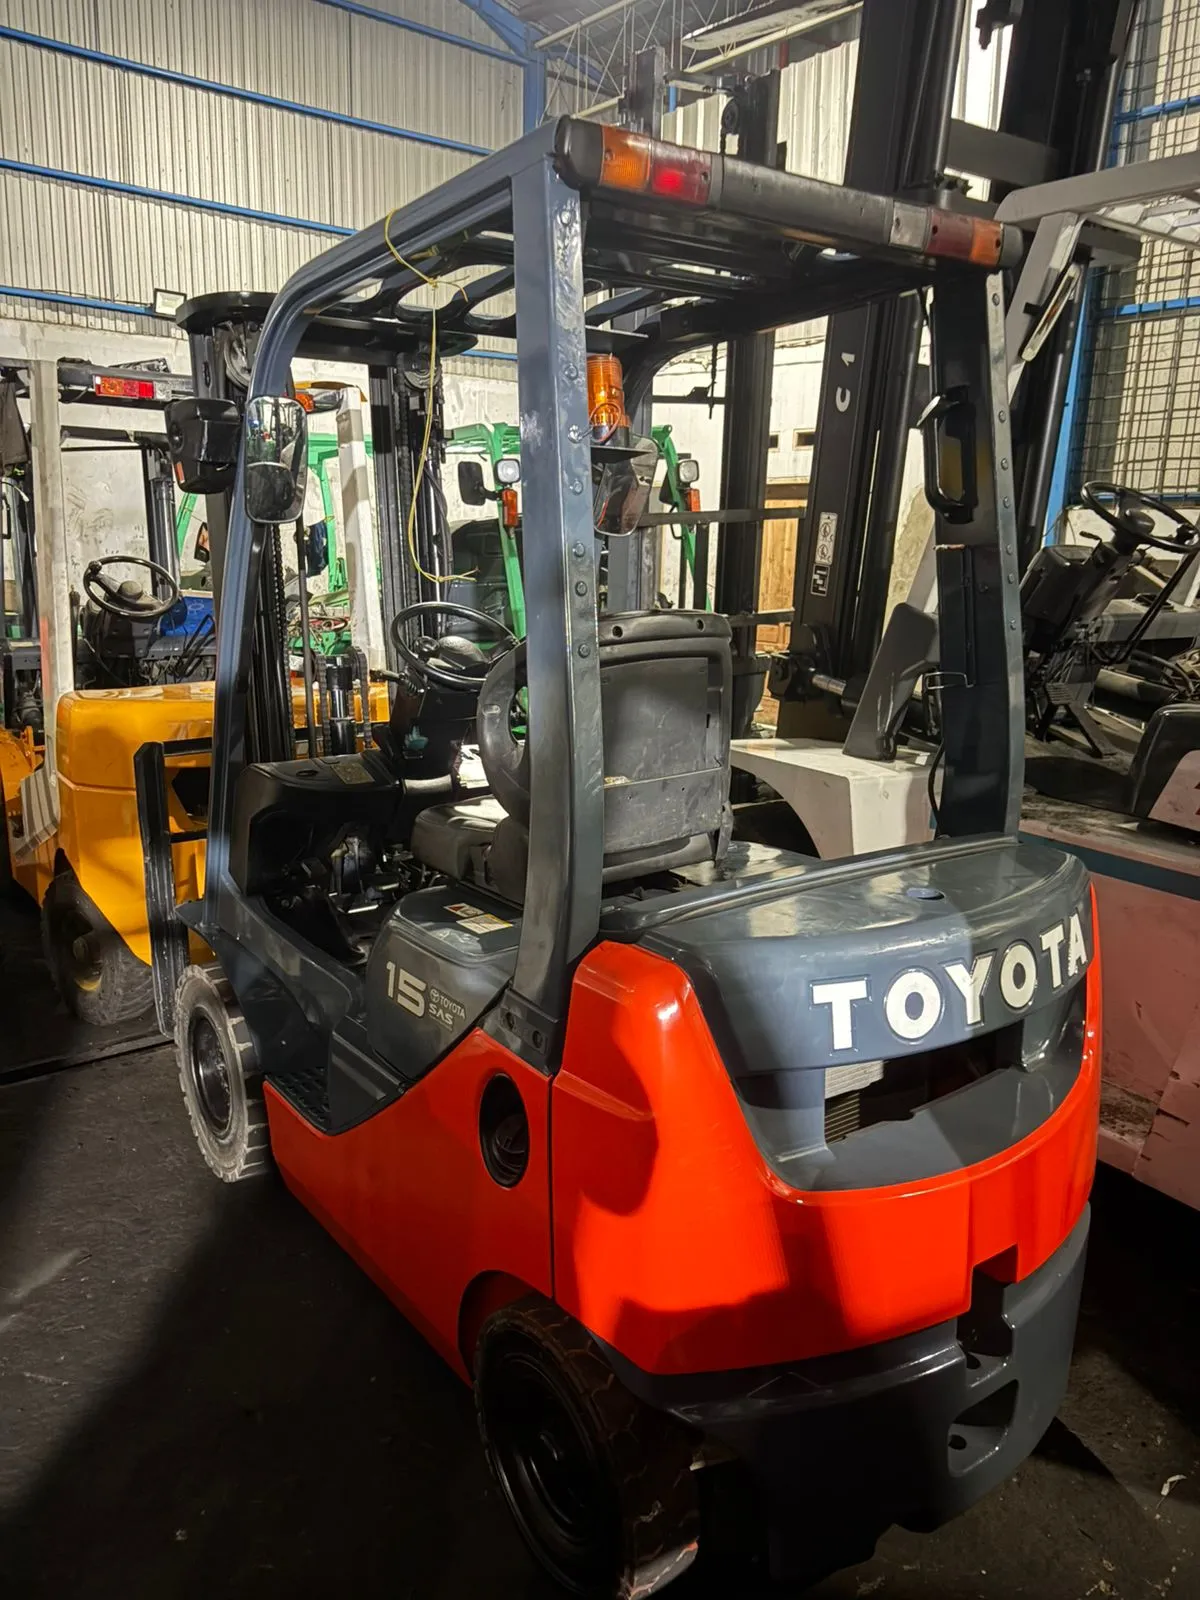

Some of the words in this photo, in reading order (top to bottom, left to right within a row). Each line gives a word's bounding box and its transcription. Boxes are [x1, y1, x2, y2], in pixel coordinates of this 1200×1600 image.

[386, 961, 427, 1017] 15
[811, 912, 1088, 1051] TOYOTA
[428, 1003, 454, 1025] SAS
[439, 994, 466, 1020] TOYOTA
